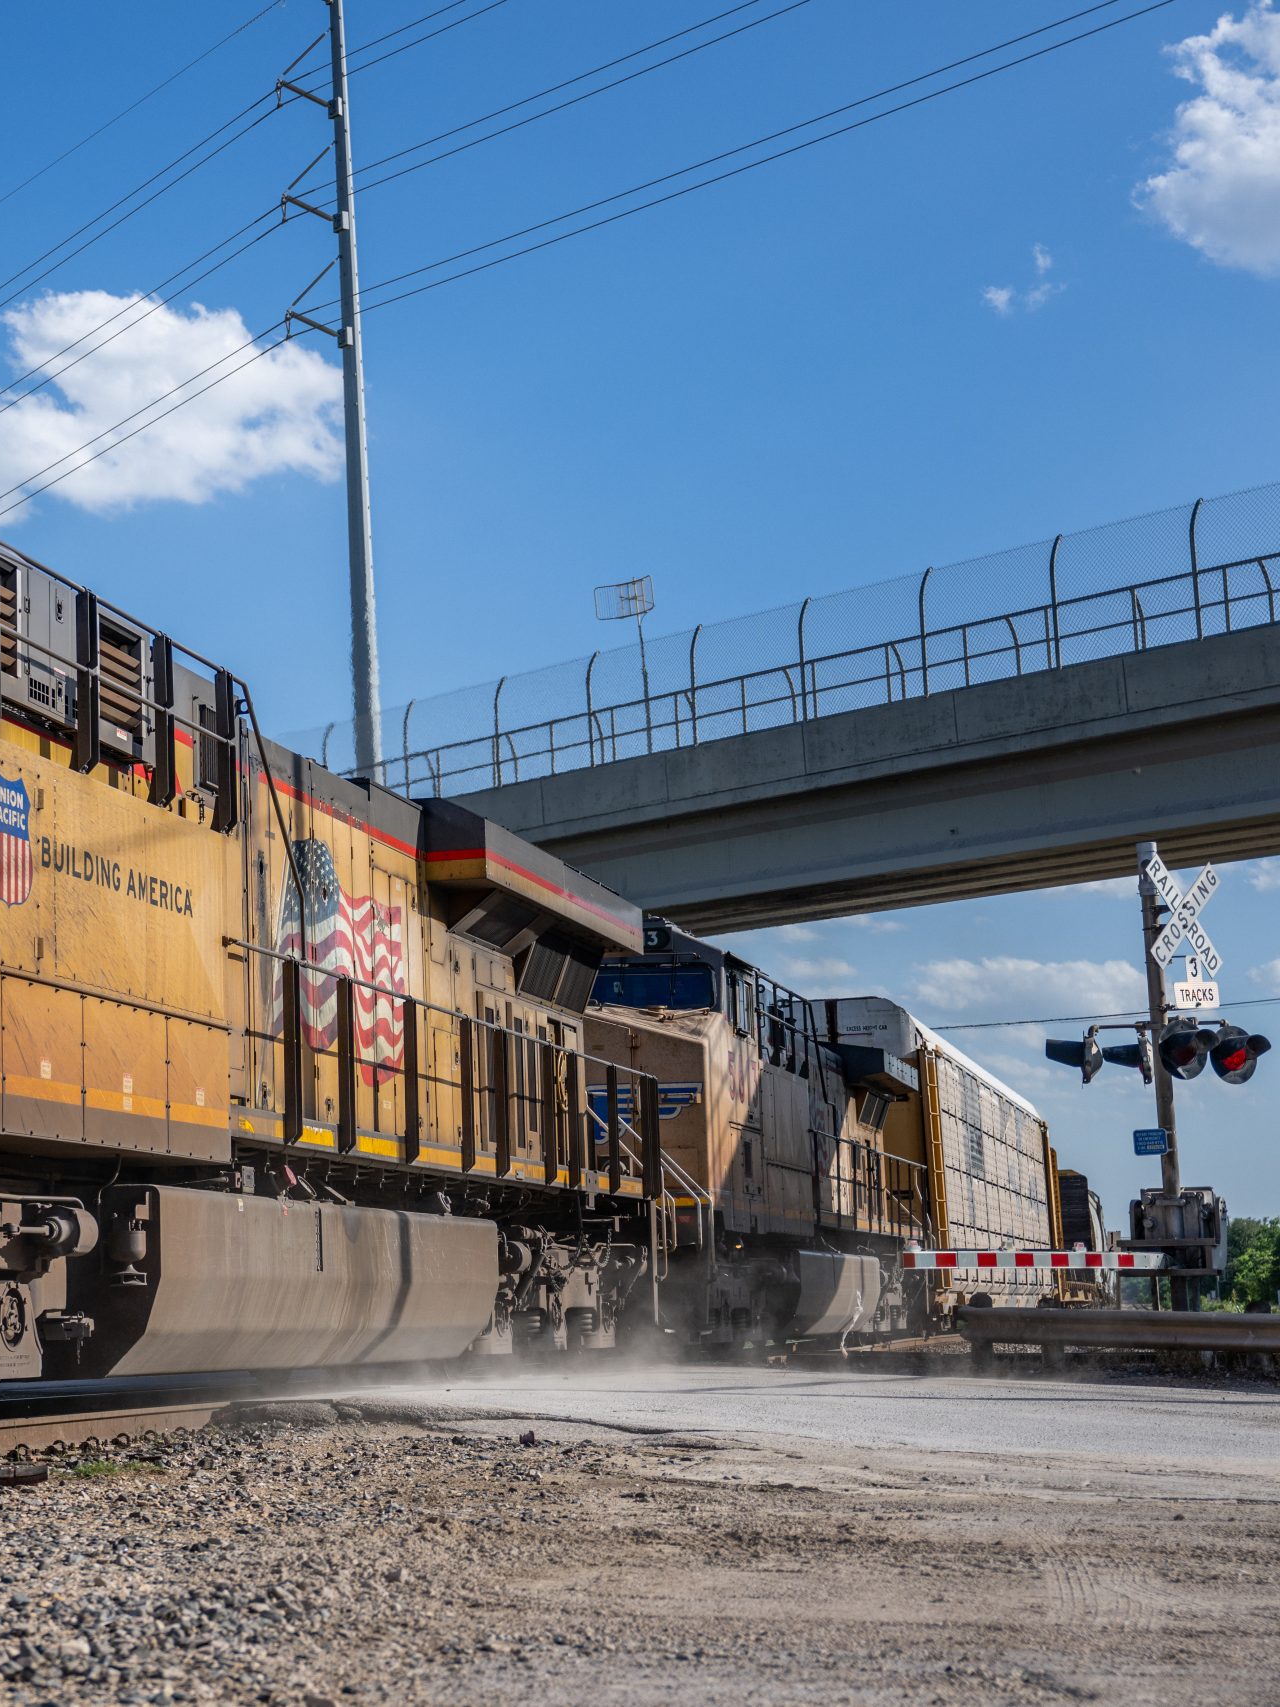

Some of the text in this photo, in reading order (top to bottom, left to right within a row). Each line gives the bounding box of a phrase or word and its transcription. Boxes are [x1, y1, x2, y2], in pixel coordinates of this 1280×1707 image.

[41, 836, 193, 918] BUILDING AMERICA
[1150, 860, 1218, 971] RAIL ROAD
[1155, 869, 1217, 963] CROSSING
[1180, 988, 1214, 1002] TRACKS
[1190, 958, 1198, 977] 3
